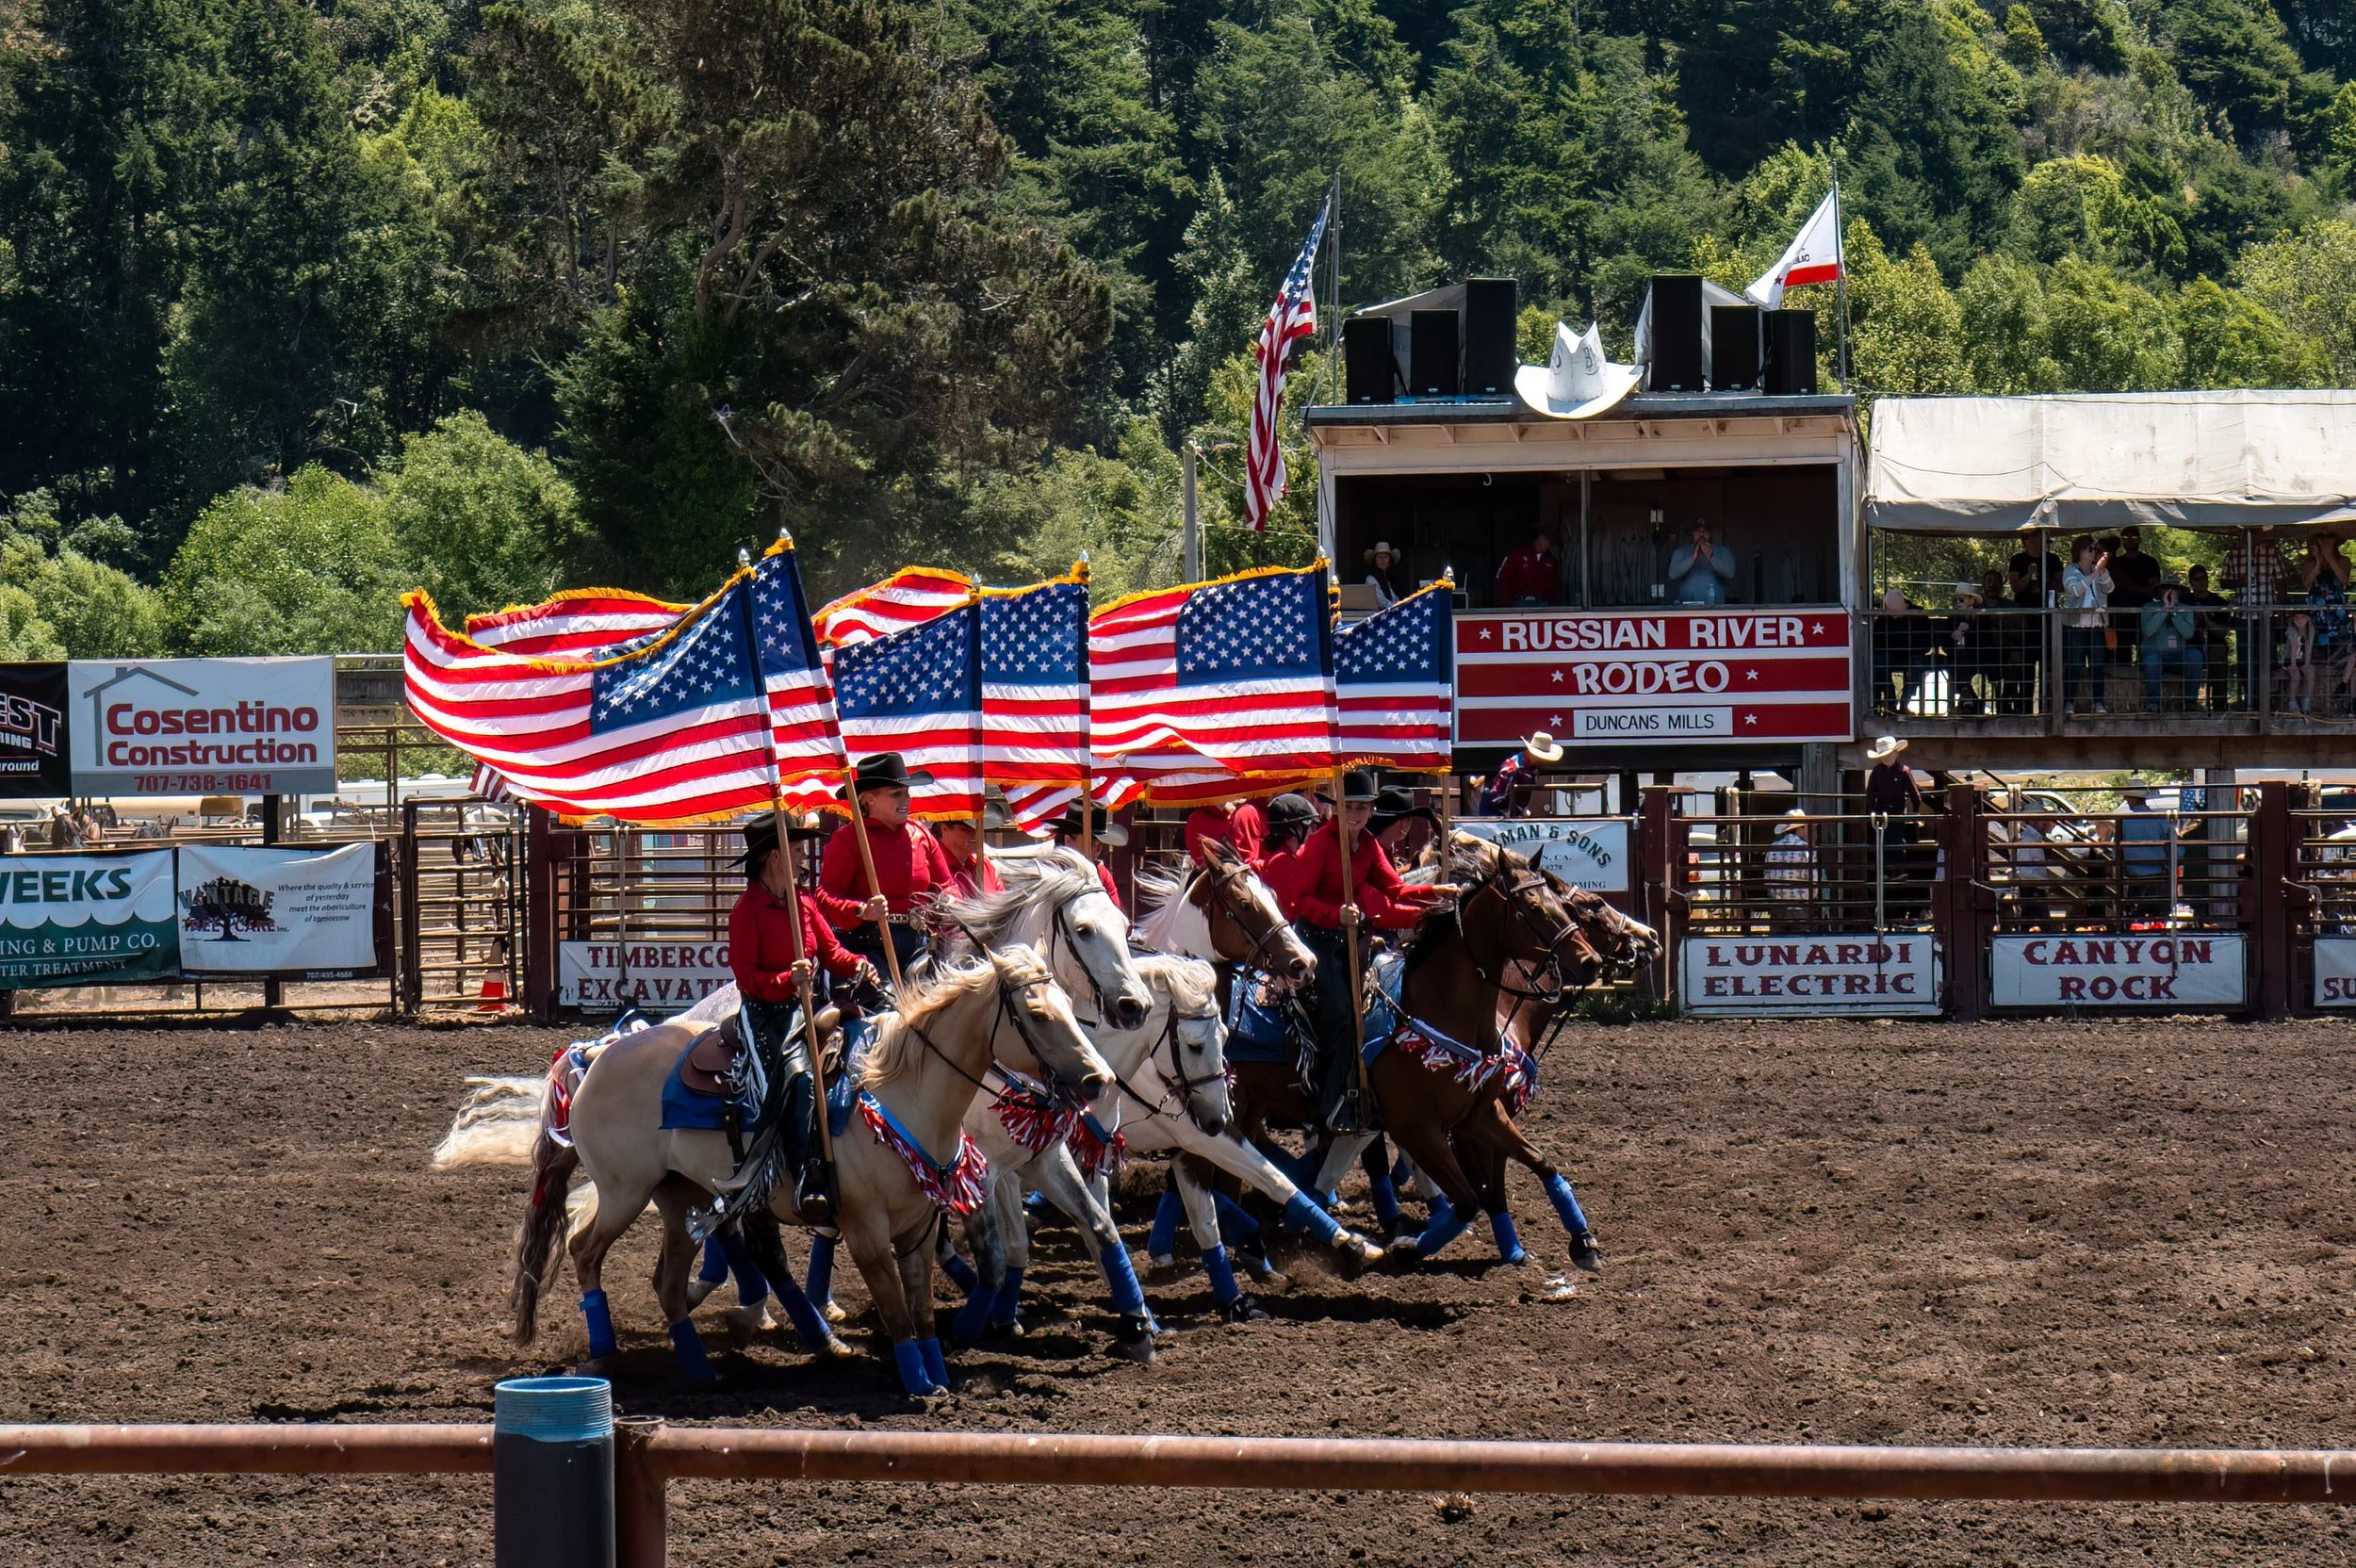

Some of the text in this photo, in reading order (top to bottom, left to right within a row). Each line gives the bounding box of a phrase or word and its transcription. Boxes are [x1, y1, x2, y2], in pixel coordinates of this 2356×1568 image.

[1502, 617, 1805, 650] RUSSIAN RIVER
[1573, 661, 1730, 694] RODEO
[106, 700, 319, 736] Cosentino
[1586, 713, 1714, 731] DUNCANS MILLS
[107, 738, 318, 766] Construction
[0, 760, 40, 772] round
[134, 773, 272, 792] 707-738-1641
[1549, 825, 1560, 840] &
[1566, 830, 1612, 867] SONS
[318, 883, 341, 891] quality
[1566, 881, 1606, 890] RMING
[315, 893, 350, 903] yesterday
[313, 915, 351, 923] tomorrow
[43, 939, 56, 954] &
[64, 935, 121, 953] PUMP
[127, 932, 161, 949] CO.
[2023, 940, 2214, 965] CANYON
[586, 945, 730, 969] TIMBERCO
[1707, 943, 1913, 967] LUNARDI
[33, 959, 127, 976] TREATMENT
[577, 979, 735, 1001] EXCAVAT
[1704, 972, 1916, 997] ELECTRIC
[2058, 976, 2179, 1001] ROCK
